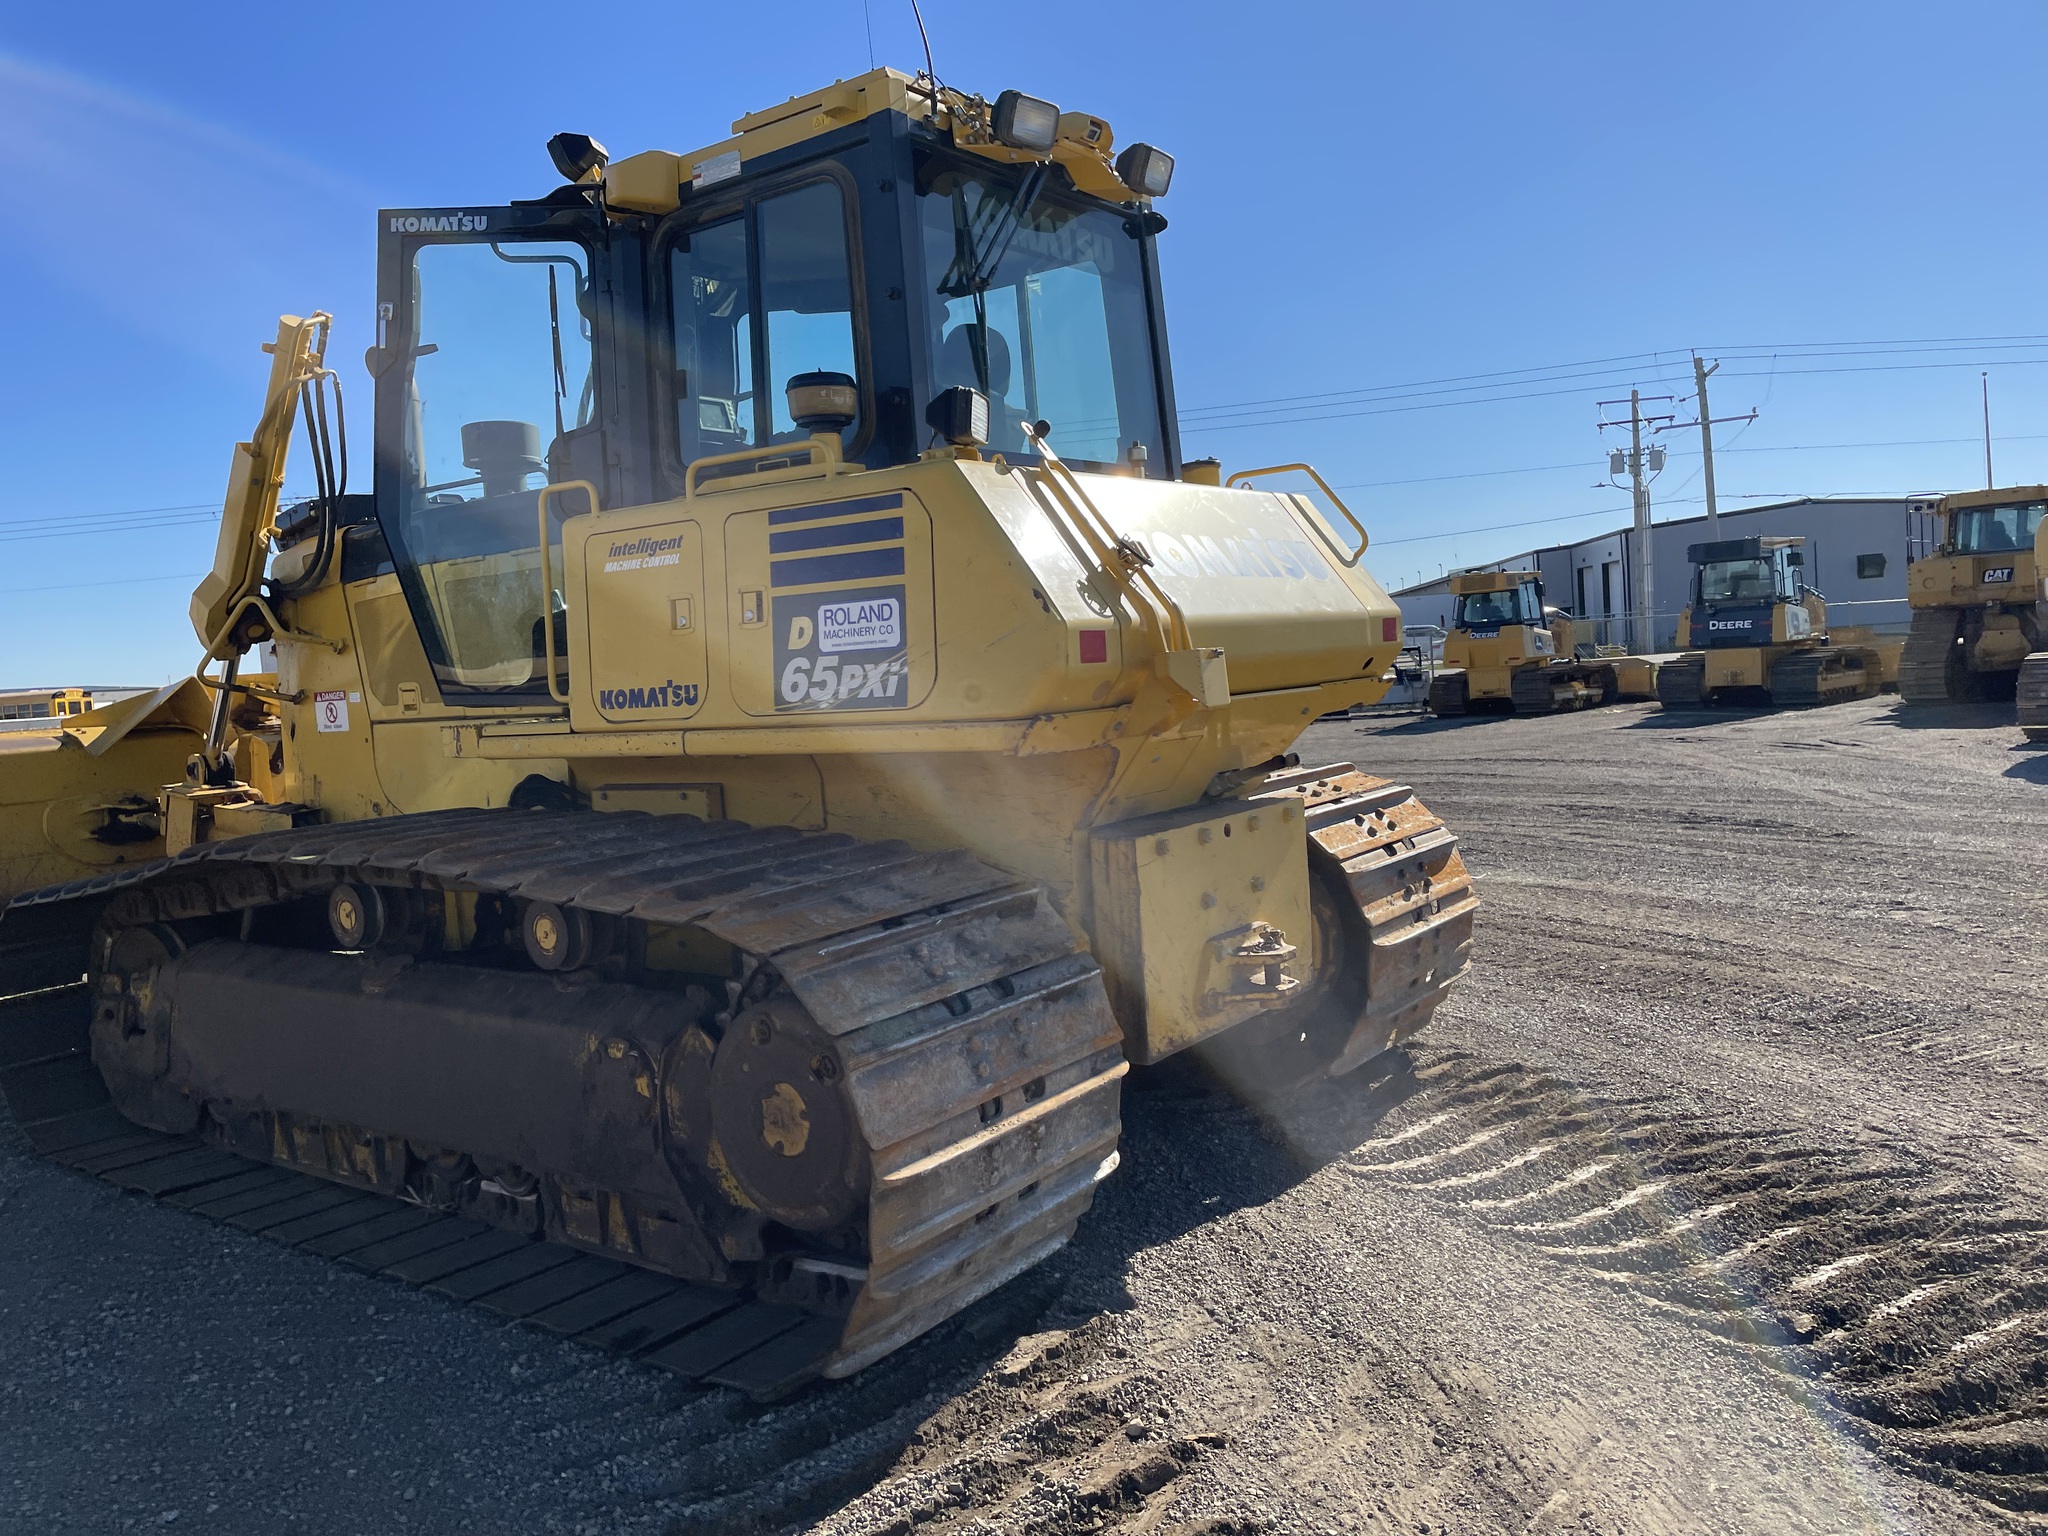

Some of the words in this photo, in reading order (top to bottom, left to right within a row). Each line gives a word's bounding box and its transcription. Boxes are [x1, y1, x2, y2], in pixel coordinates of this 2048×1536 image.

[390, 212, 488, 233] KOMATSU
[608, 534, 684, 558] intelligent
[604, 558, 642, 573] MACHINE
[642, 553, 680, 568] CONTROL
[1984, 569, 2011, 583] CAT
[823, 603, 893, 627] ROLAND
[1709, 620, 1753, 630] DEERE
[788, 616, 813, 650] D
[823, 626, 877, 640] MACHINERY
[879, 624, 895, 636] CO.
[1469, 631, 1500, 639] DEERE
[321, 691, 345, 701] DANGER
[600, 679, 698, 709] KOMATSU
